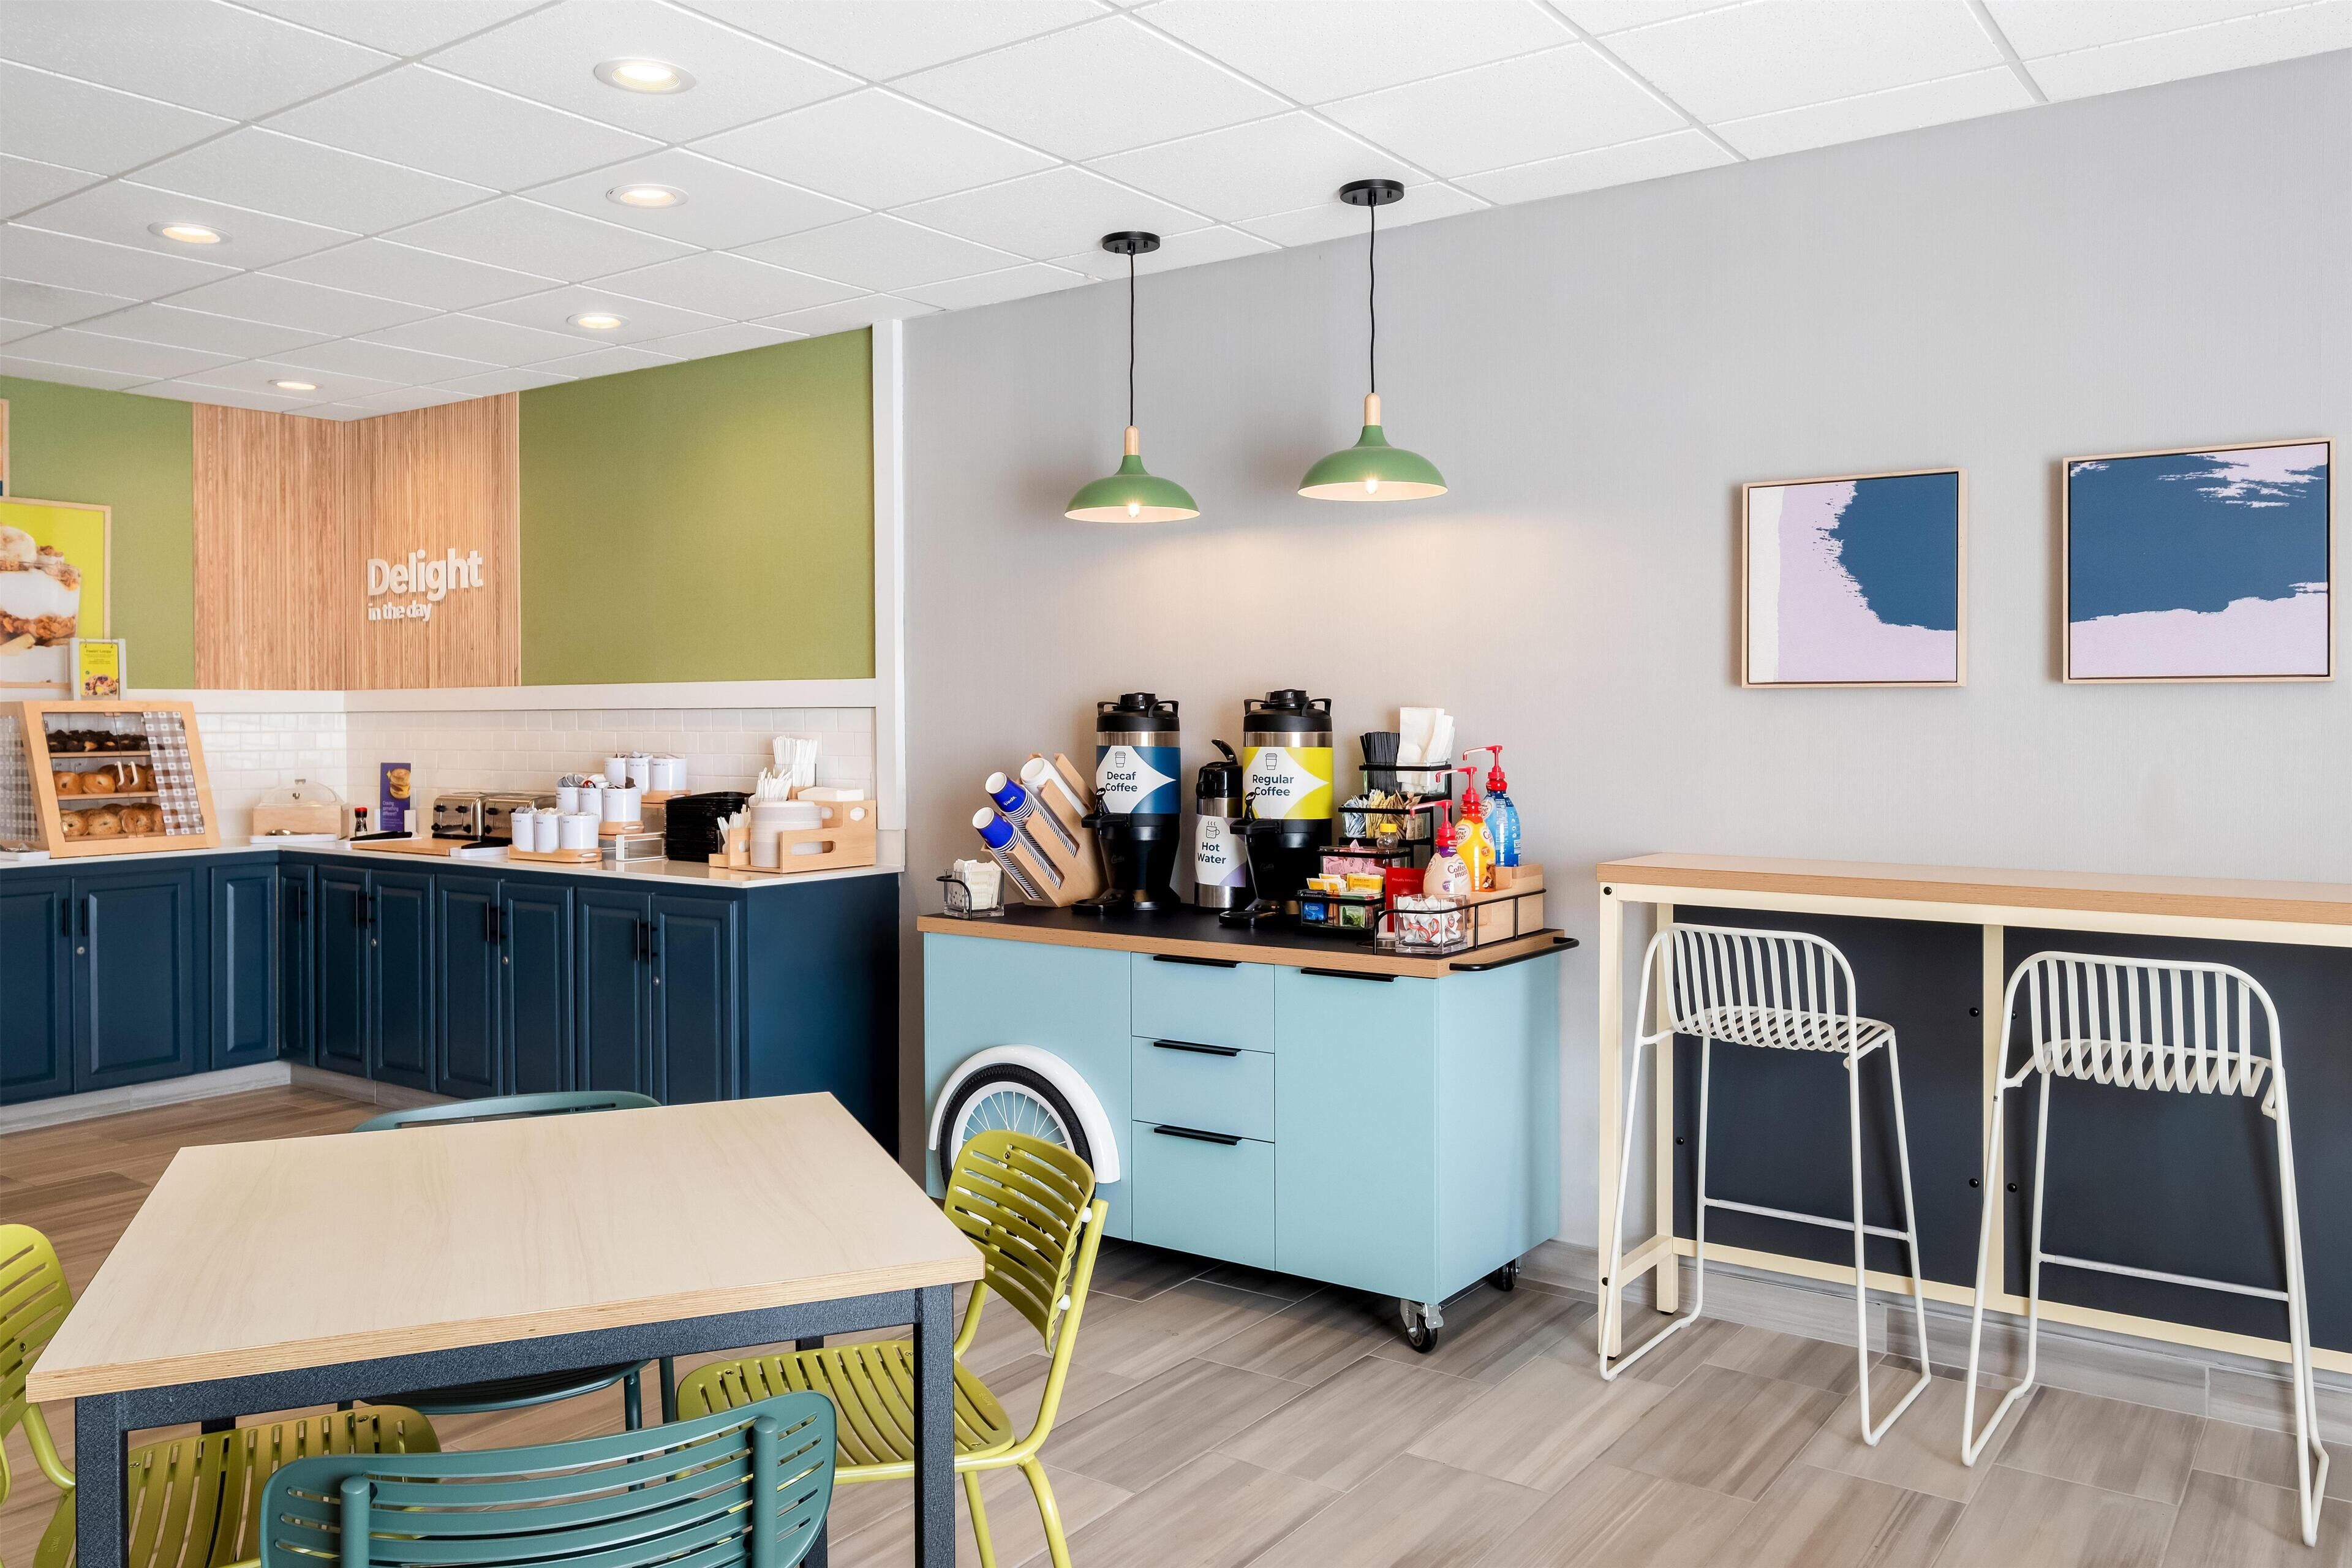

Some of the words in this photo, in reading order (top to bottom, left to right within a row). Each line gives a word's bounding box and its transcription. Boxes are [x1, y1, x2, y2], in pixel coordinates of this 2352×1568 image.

[367, 548, 483, 601] Delight
[368, 603, 381, 620] in
[382, 601, 405, 619] the
[406, 600, 432, 622] day
[1107, 771, 1136, 780] Decaf
[1253, 774, 1294, 786] Regular
[1105, 783, 1137, 792] Coffee
[1254, 786, 1290, 796] Coffee
[1202, 842, 1219, 851] Hot
[1197, 853, 1226, 864] Water
